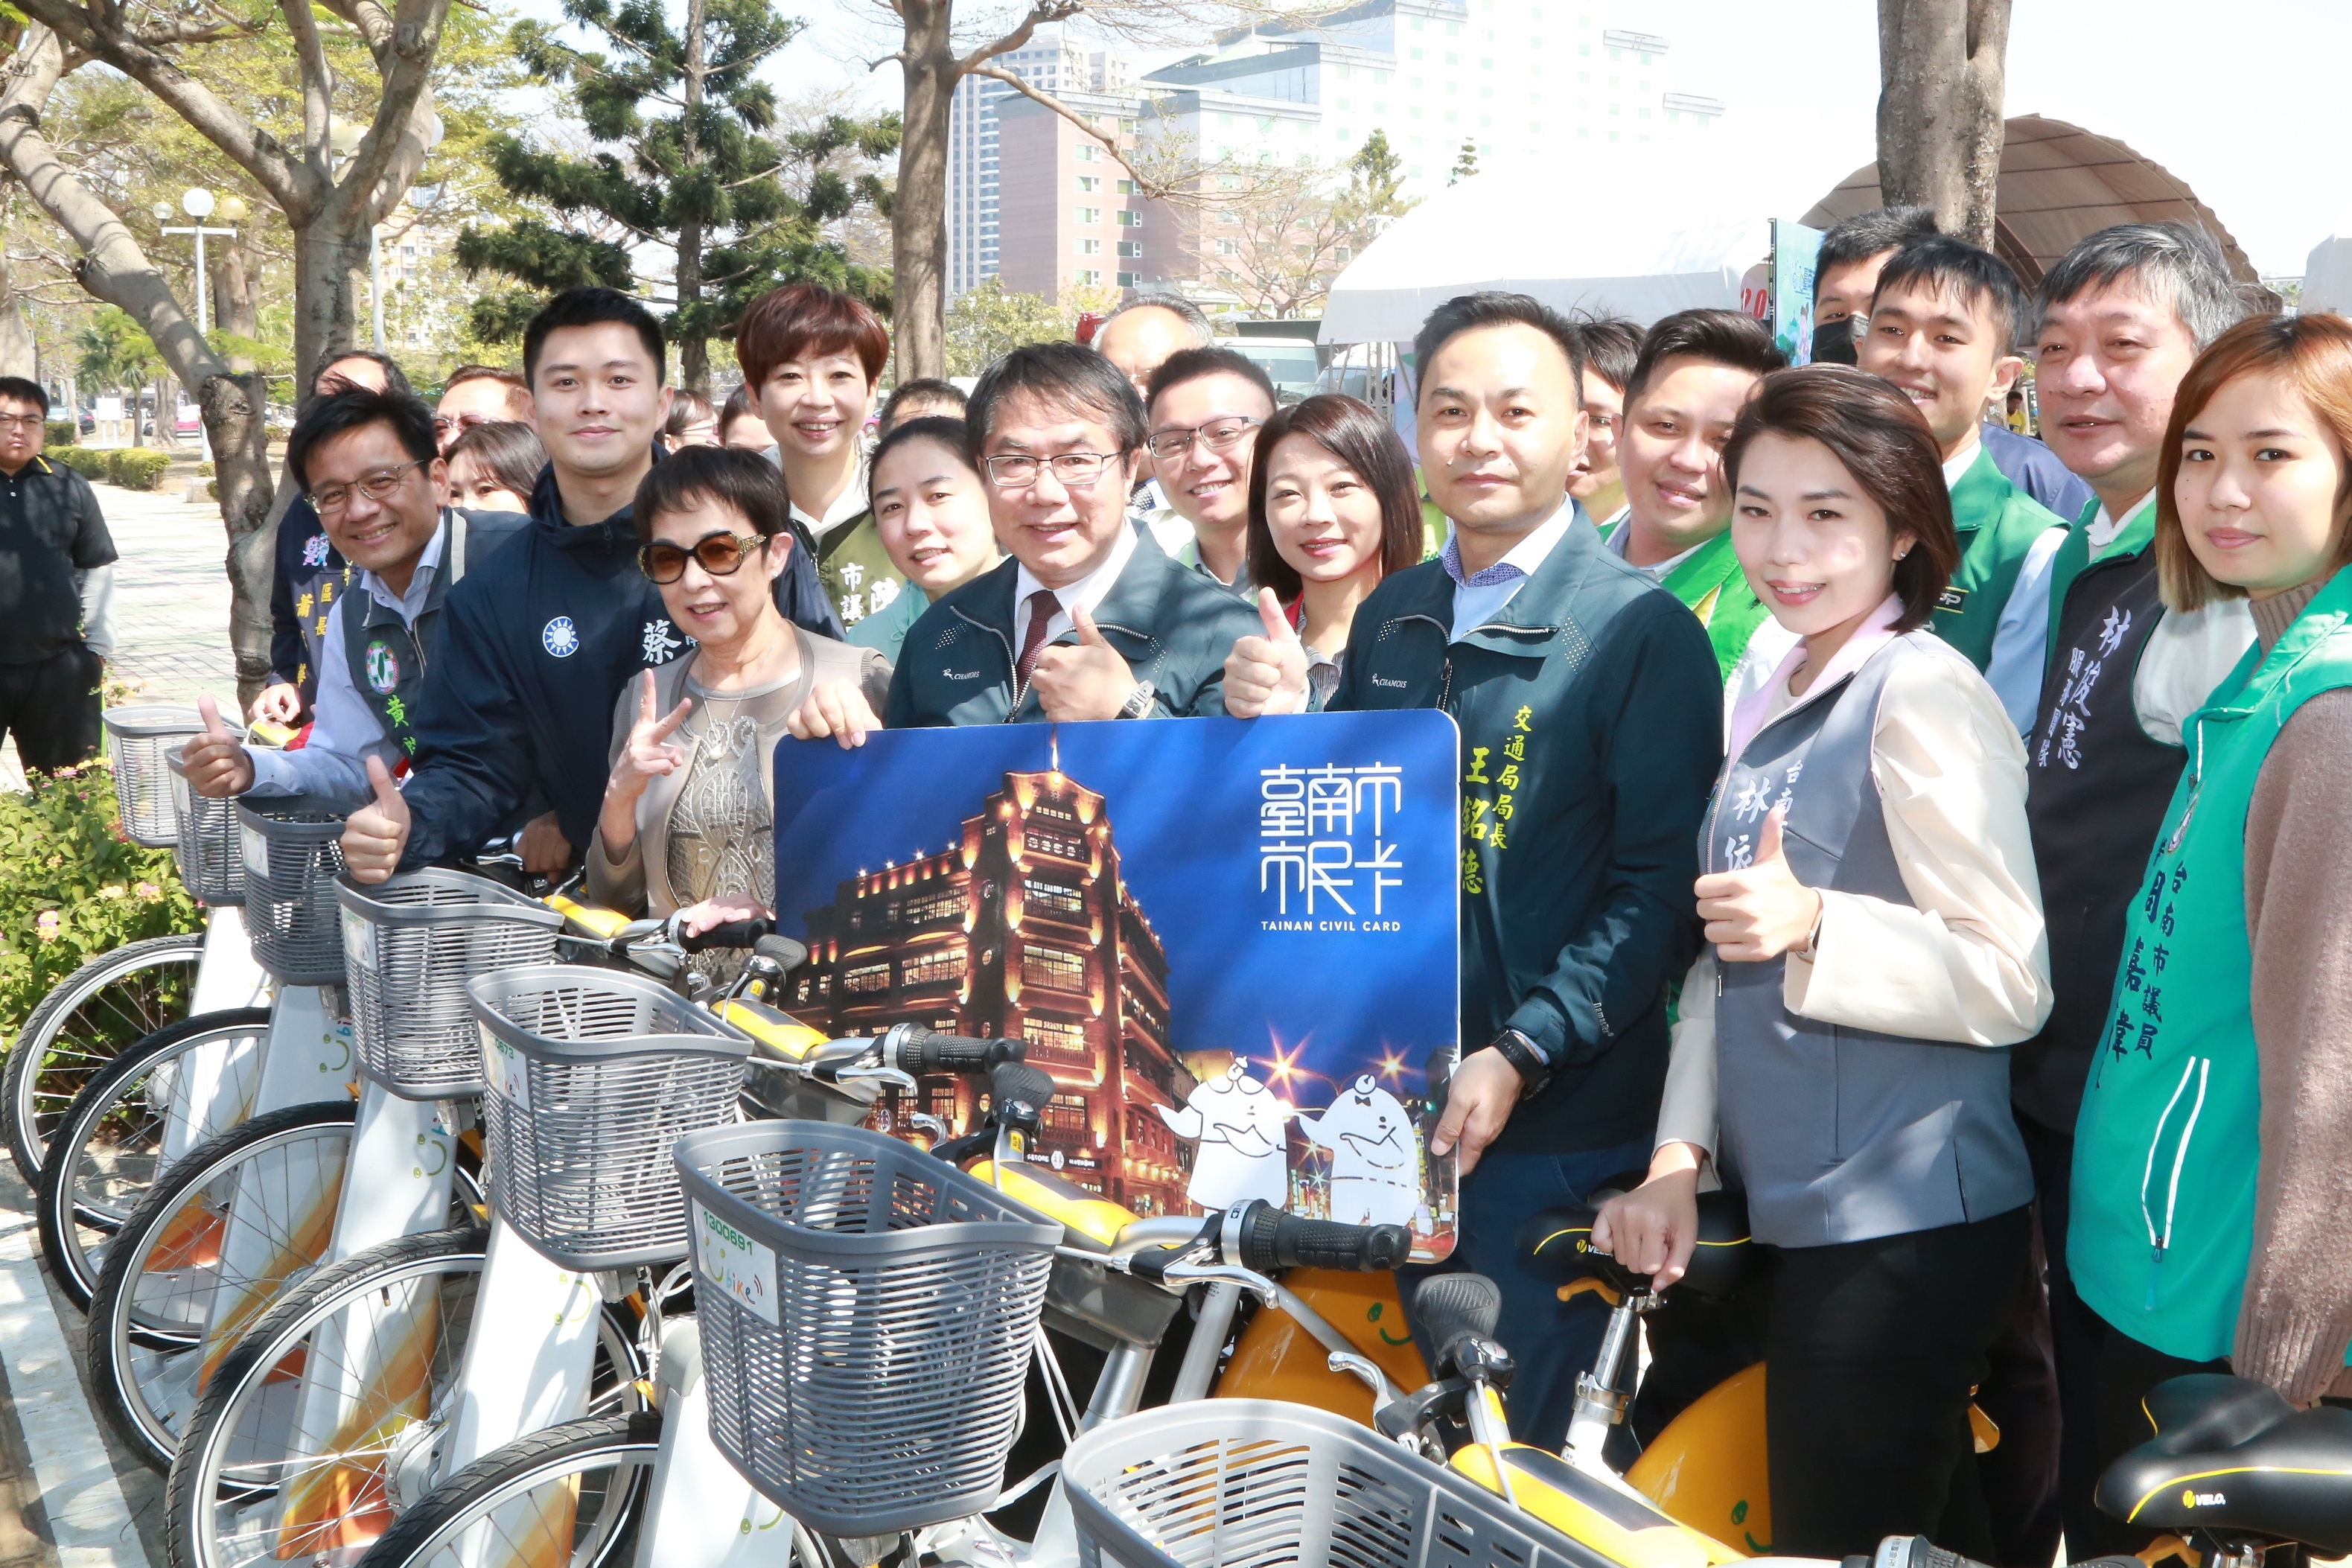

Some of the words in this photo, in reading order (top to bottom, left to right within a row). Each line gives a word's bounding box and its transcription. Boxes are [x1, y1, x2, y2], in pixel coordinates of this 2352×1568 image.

[314, 582, 333, 636] 區長
[840, 562, 864, 633] 市議
[642, 619, 682, 665] 蔡
[1379, 678, 1407, 689] CHAMOIS
[1489, 705, 1533, 849] 交通局局長
[1774, 759, 1803, 826] 台南
[1460, 747, 1491, 894] 王銘德
[1261, 921, 1313, 931] TAINAN
[1319, 921, 1356, 931] CIVIL
[1363, 921, 1400, 932] CARD
[2135, 860, 2187, 1060] 台南市議員
[704, 1211, 753, 1256] 1300691
[312, 1278, 348, 1306] KENDA
